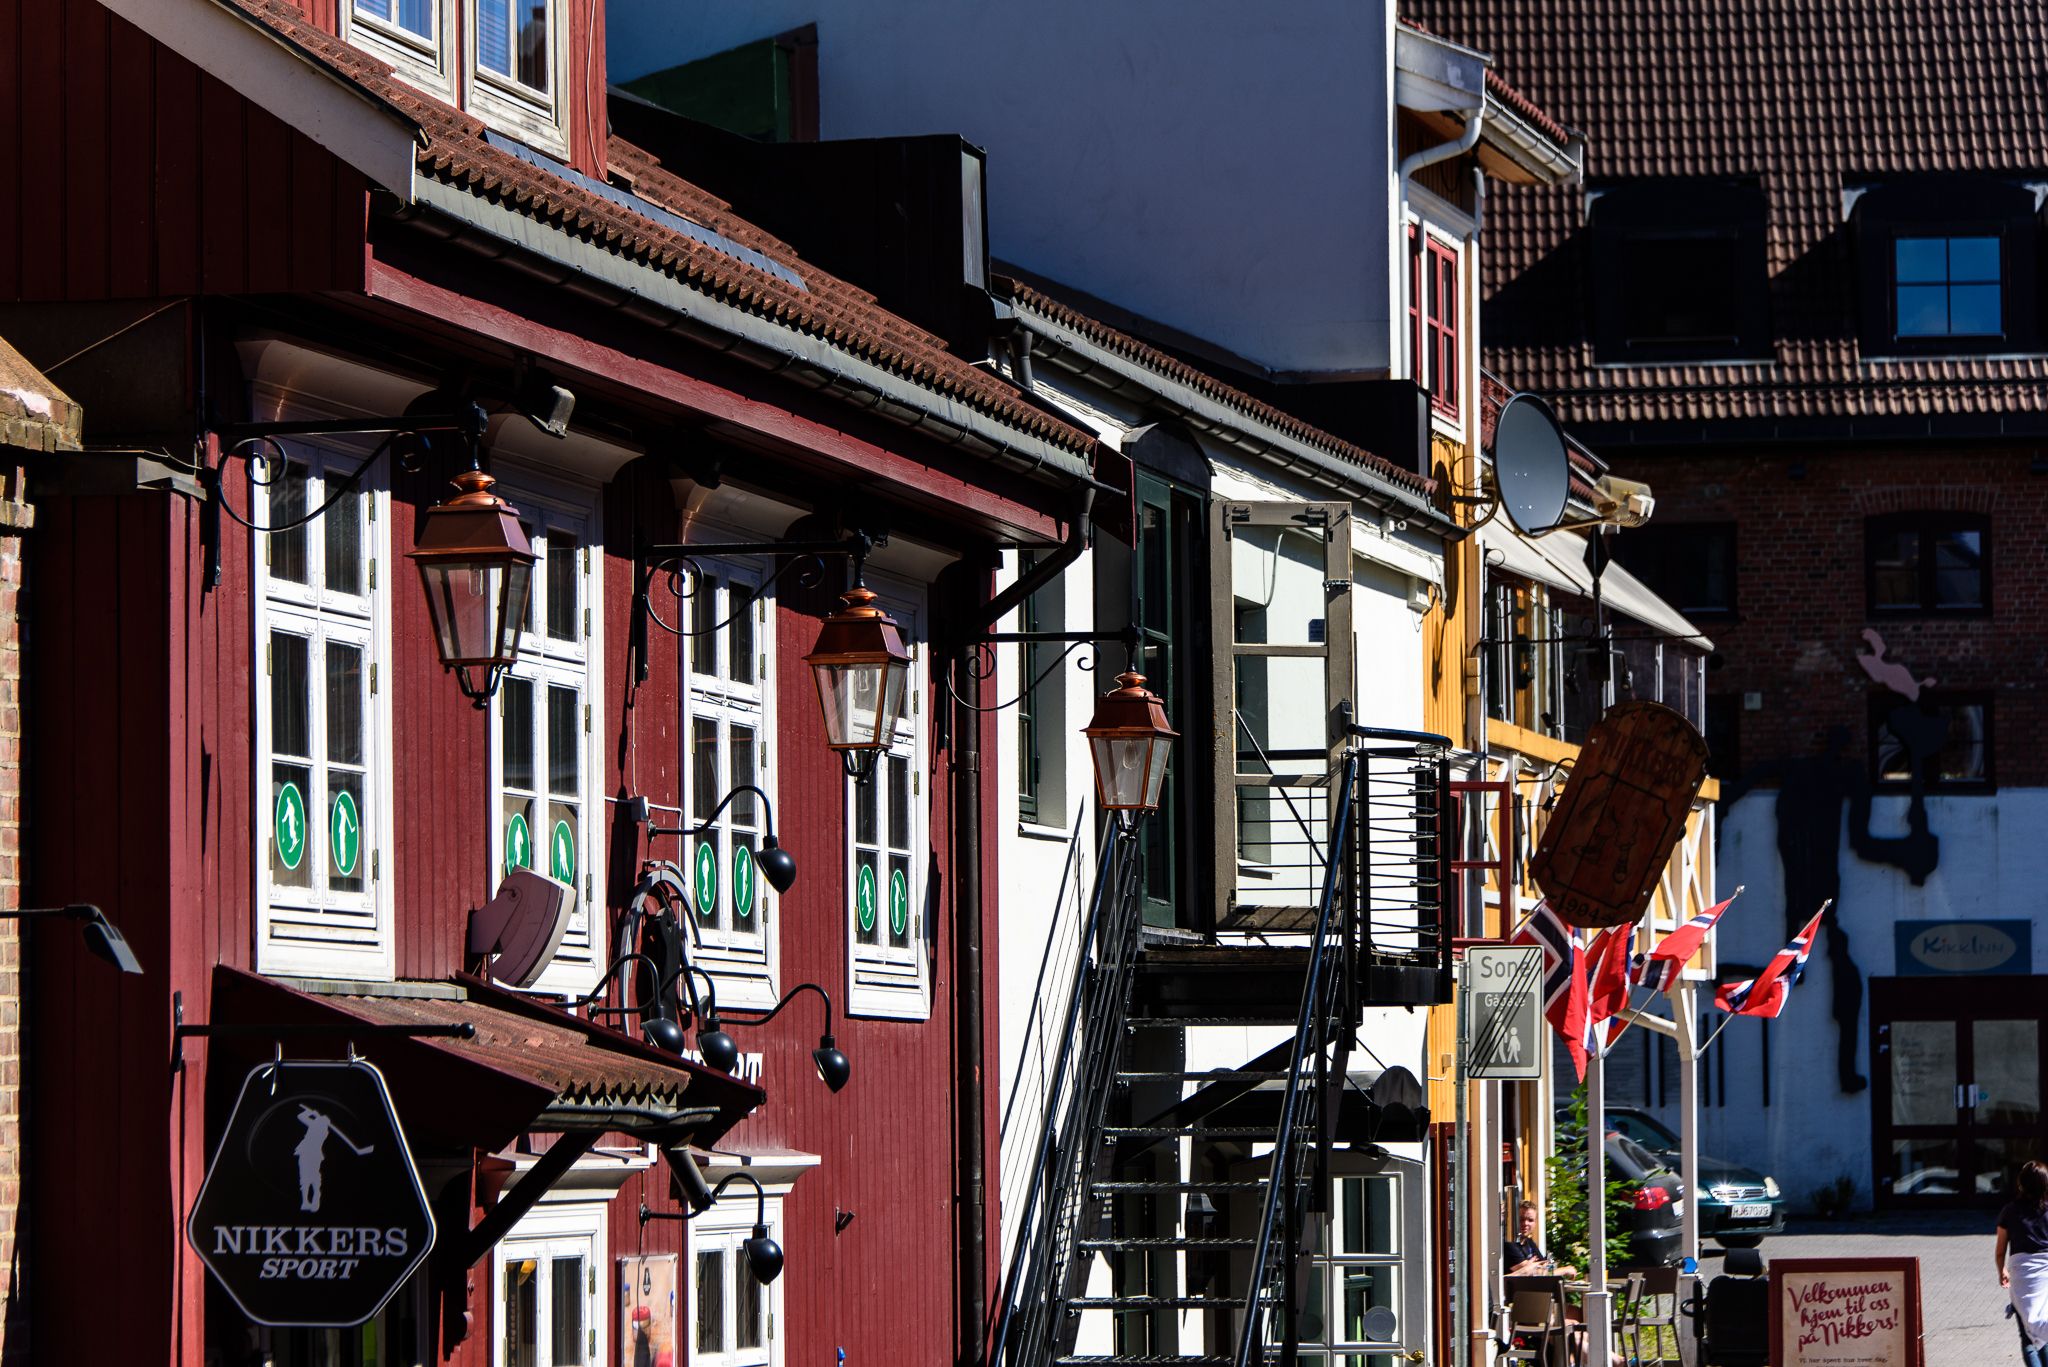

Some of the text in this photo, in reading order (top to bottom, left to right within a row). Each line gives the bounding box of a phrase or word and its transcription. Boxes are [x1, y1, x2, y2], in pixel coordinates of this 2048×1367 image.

[1481, 956, 1531, 978] Sone
[1484, 993, 1526, 1011] Gågate
[213, 1226, 408, 1256] NIKKERS
[259, 1258, 359, 1279] SPORT
[1787, 1282, 1892, 1313] Velkommen
[1800, 1295, 1890, 1328] hjem til oss
[1798, 1308, 1899, 1353] på Nikkers!
